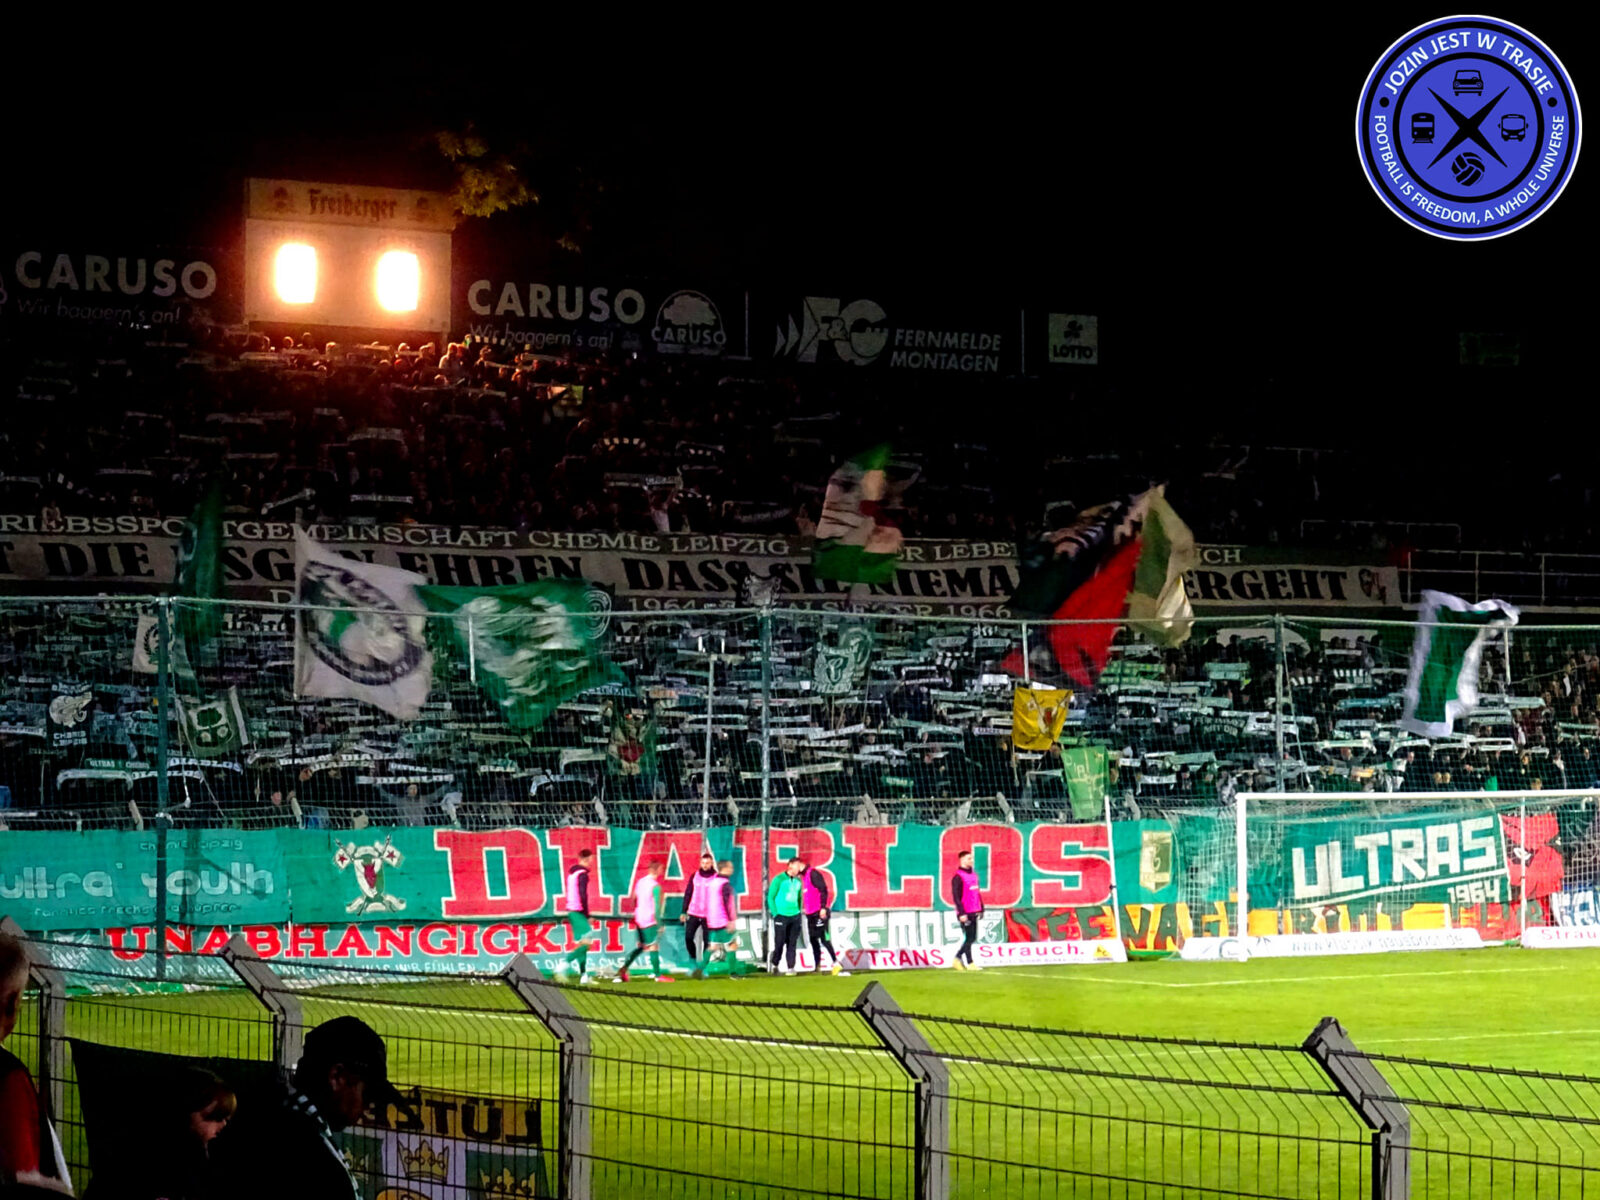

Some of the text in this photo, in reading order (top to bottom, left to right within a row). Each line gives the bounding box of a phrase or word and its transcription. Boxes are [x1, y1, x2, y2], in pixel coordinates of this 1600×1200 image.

[308, 188, 397, 222] Freiberger
[15, 250, 218, 300] CARUSO
[467, 279, 646, 325] CARUSO
[151, 305, 181, 325] an!
[651, 326, 728, 345] CARUSO
[895, 328, 1001, 351] FERNMELDE
[890, 350, 999, 373] MONTAGEN
[1053, 344, 1093, 360] LOTTO
[528, 530, 660, 552] CHEMIE
[671, 536, 790, 555] LEIPZIG
[39, 542, 155, 577] DIE
[433, 822, 1115, 918] DIABLOS
[1291, 815, 1498, 900] ULTRAS
[1448, 879, 1500, 904] 1964
[869, 948, 945, 967] TRANS
